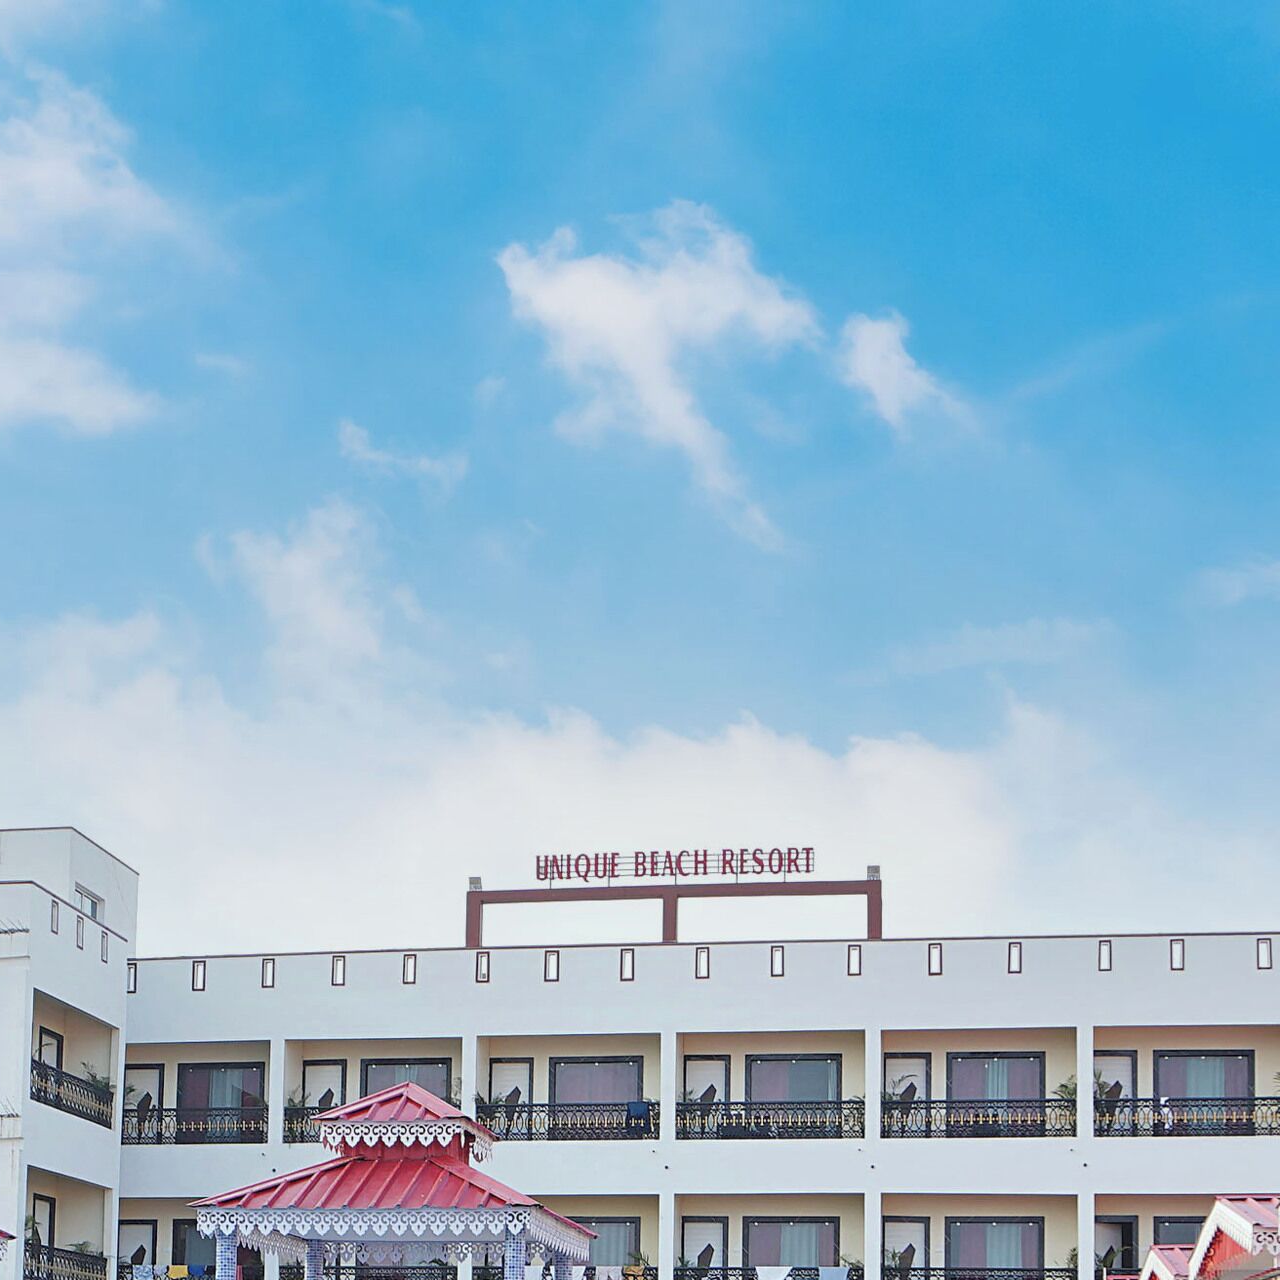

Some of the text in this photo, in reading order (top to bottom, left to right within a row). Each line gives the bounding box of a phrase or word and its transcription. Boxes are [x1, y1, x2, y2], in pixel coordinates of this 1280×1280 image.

[535, 847, 814, 882] UNIQUE BEACH RESORT
